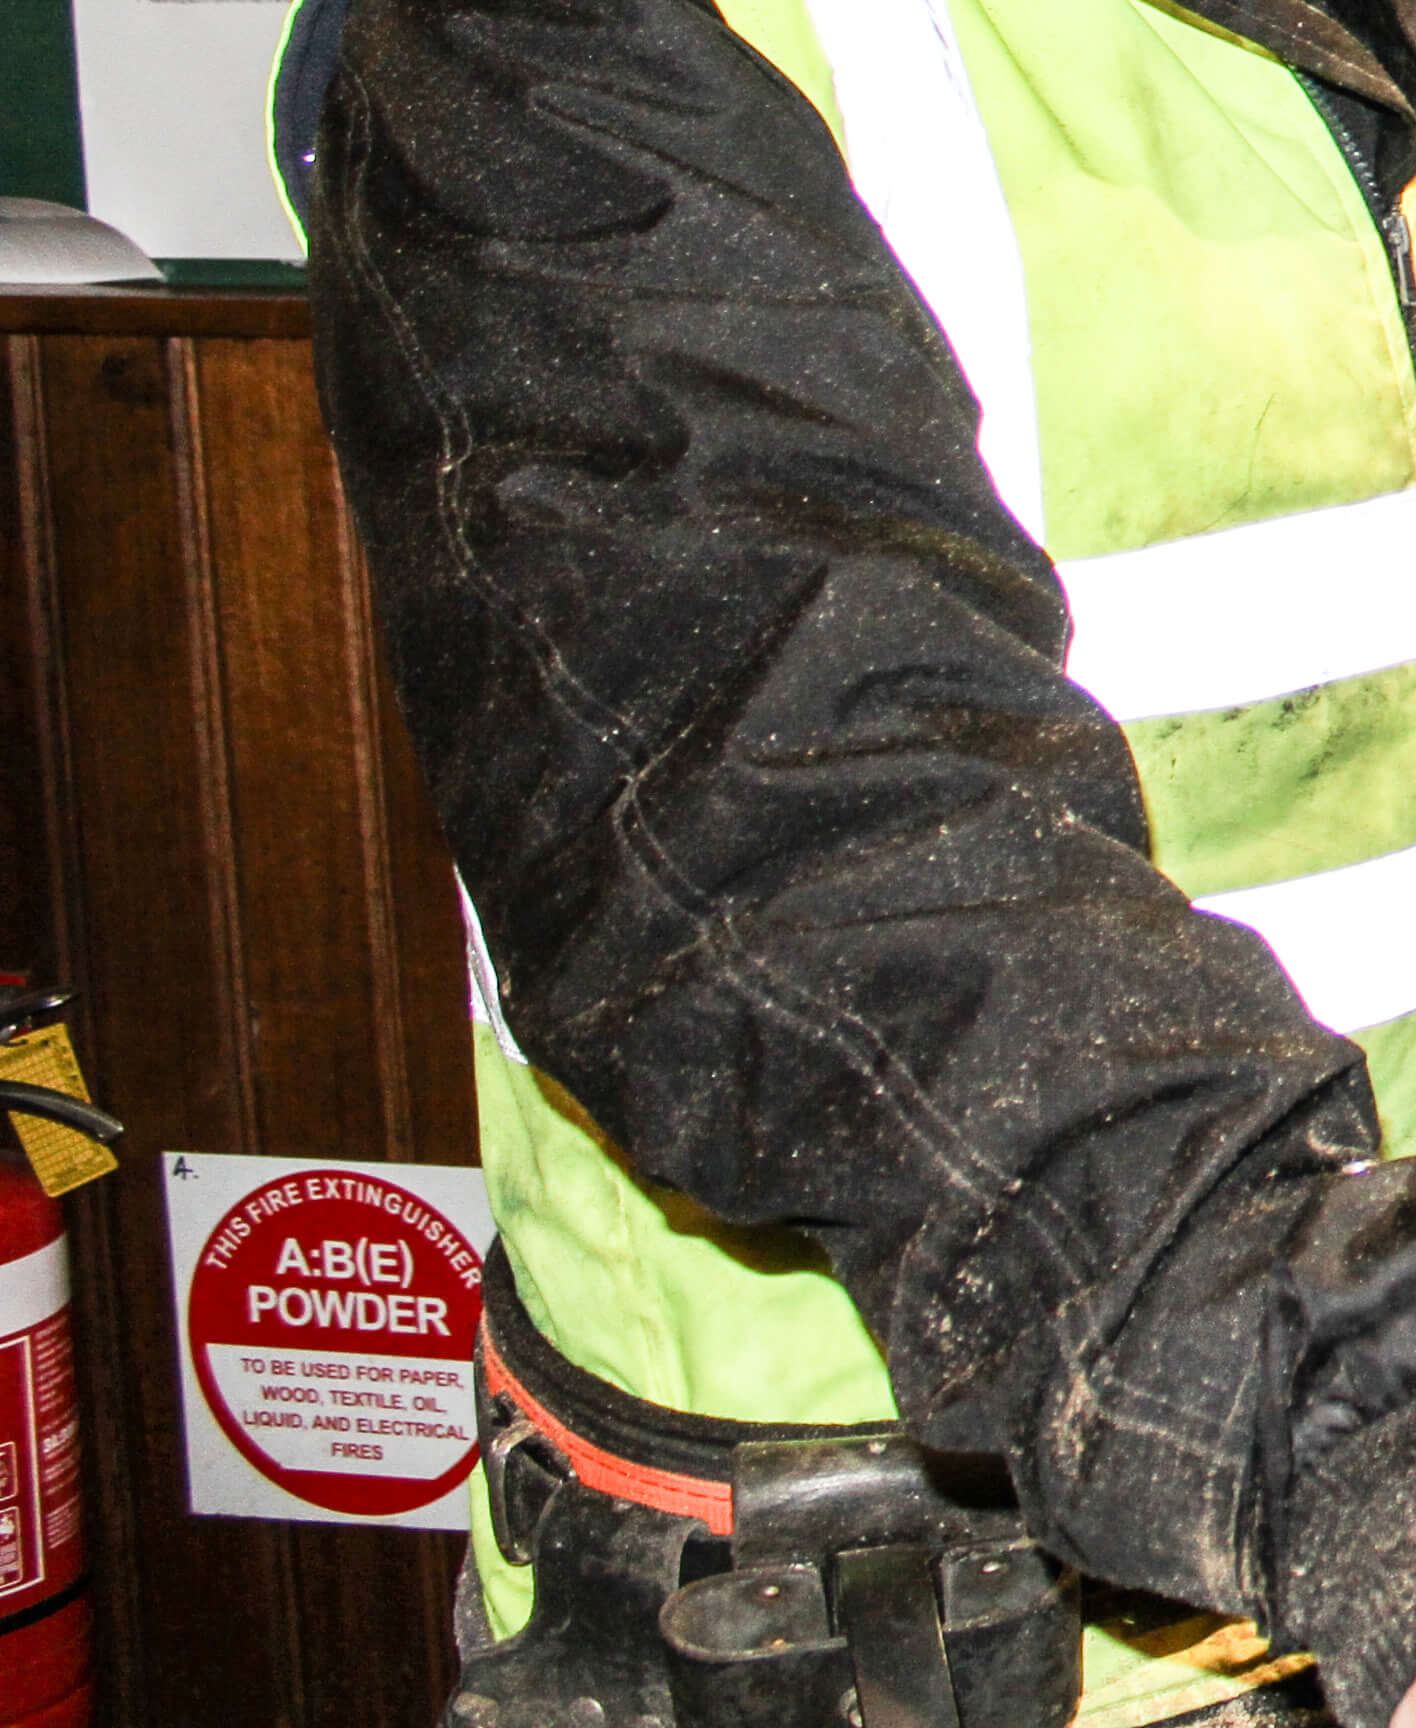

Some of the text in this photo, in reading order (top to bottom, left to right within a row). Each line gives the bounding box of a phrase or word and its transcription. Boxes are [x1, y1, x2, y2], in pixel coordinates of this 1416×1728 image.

[204, 1177, 482, 1289] THIS FIRE EXTINGUISHER
[275, 1236, 414, 1289] A:B(E)
[247, 1284, 452, 1336] POWDER
[240, 1358, 465, 1389] TO BE USED FOR PAPER,
[260, 1384, 324, 1406] WOOD,
[243, 1410, 470, 1441] LIQUID, AND ELECTRICAL
[331, 1442, 384, 1460] FIRES
